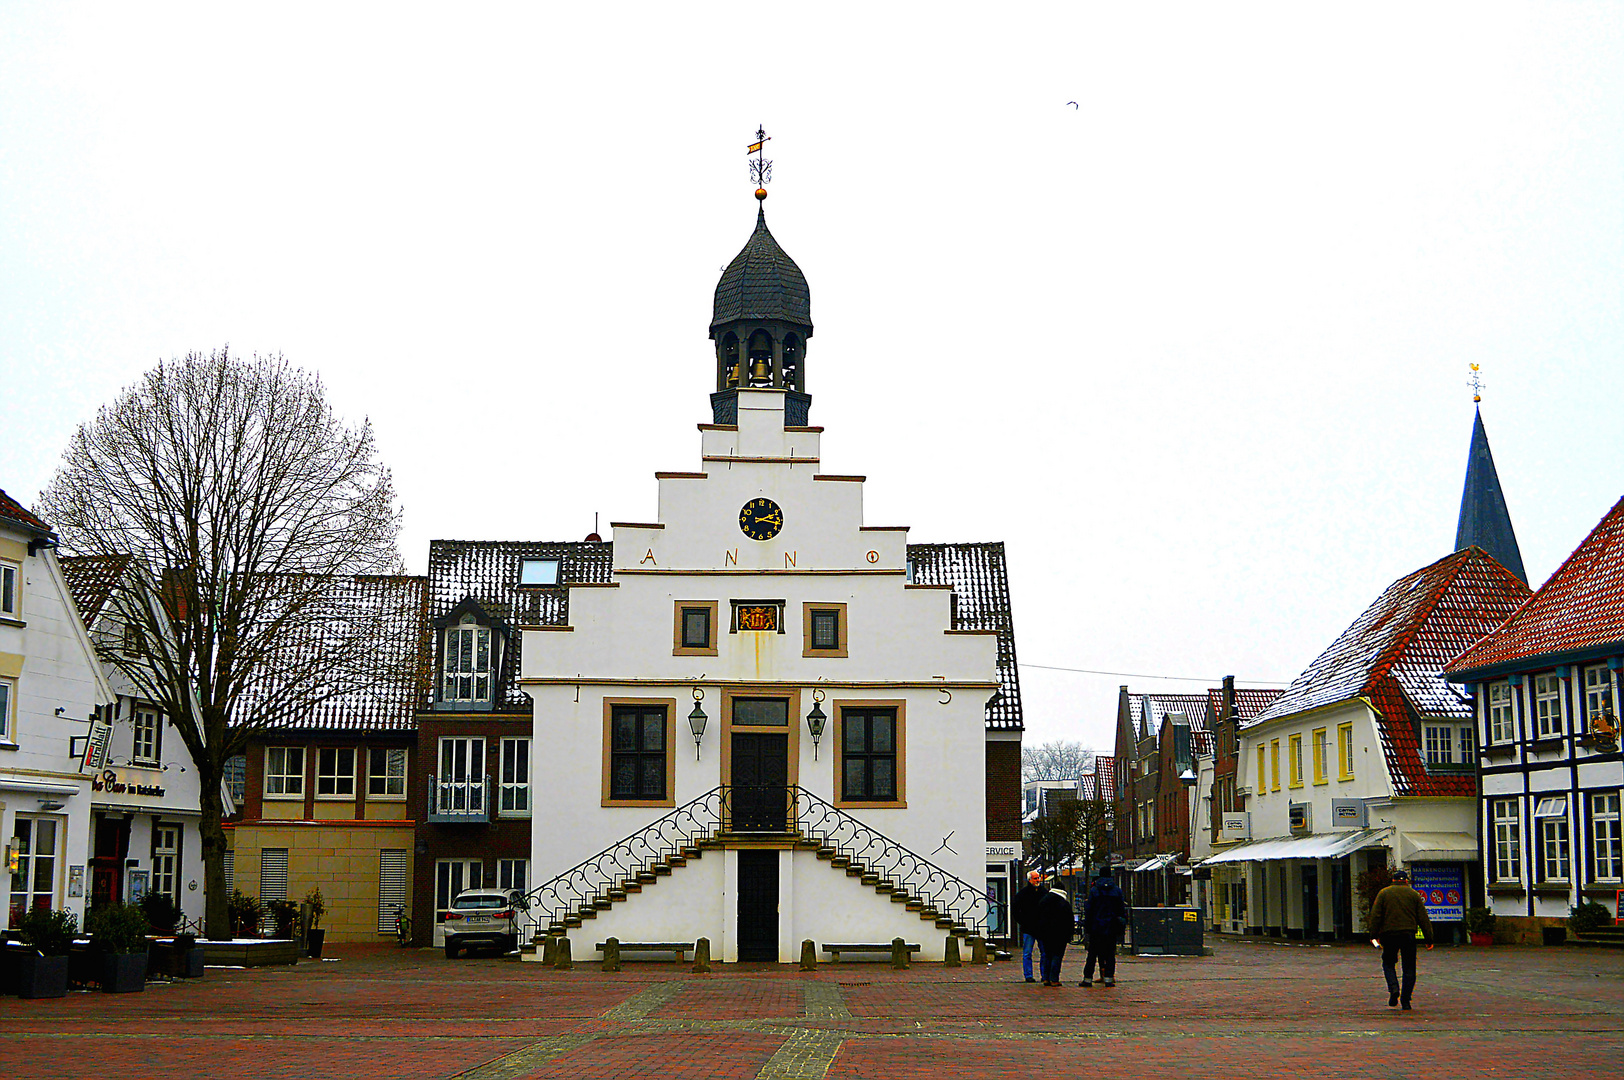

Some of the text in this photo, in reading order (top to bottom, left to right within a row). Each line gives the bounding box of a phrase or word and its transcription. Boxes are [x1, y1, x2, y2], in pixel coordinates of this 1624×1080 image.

[92, 774, 104, 792] ba
[103, 770, 126, 793] Can
[986, 847, 1014, 855] ERVICE
[1432, 892, 1441, 902] %
[1448, 892, 1458, 902] %
